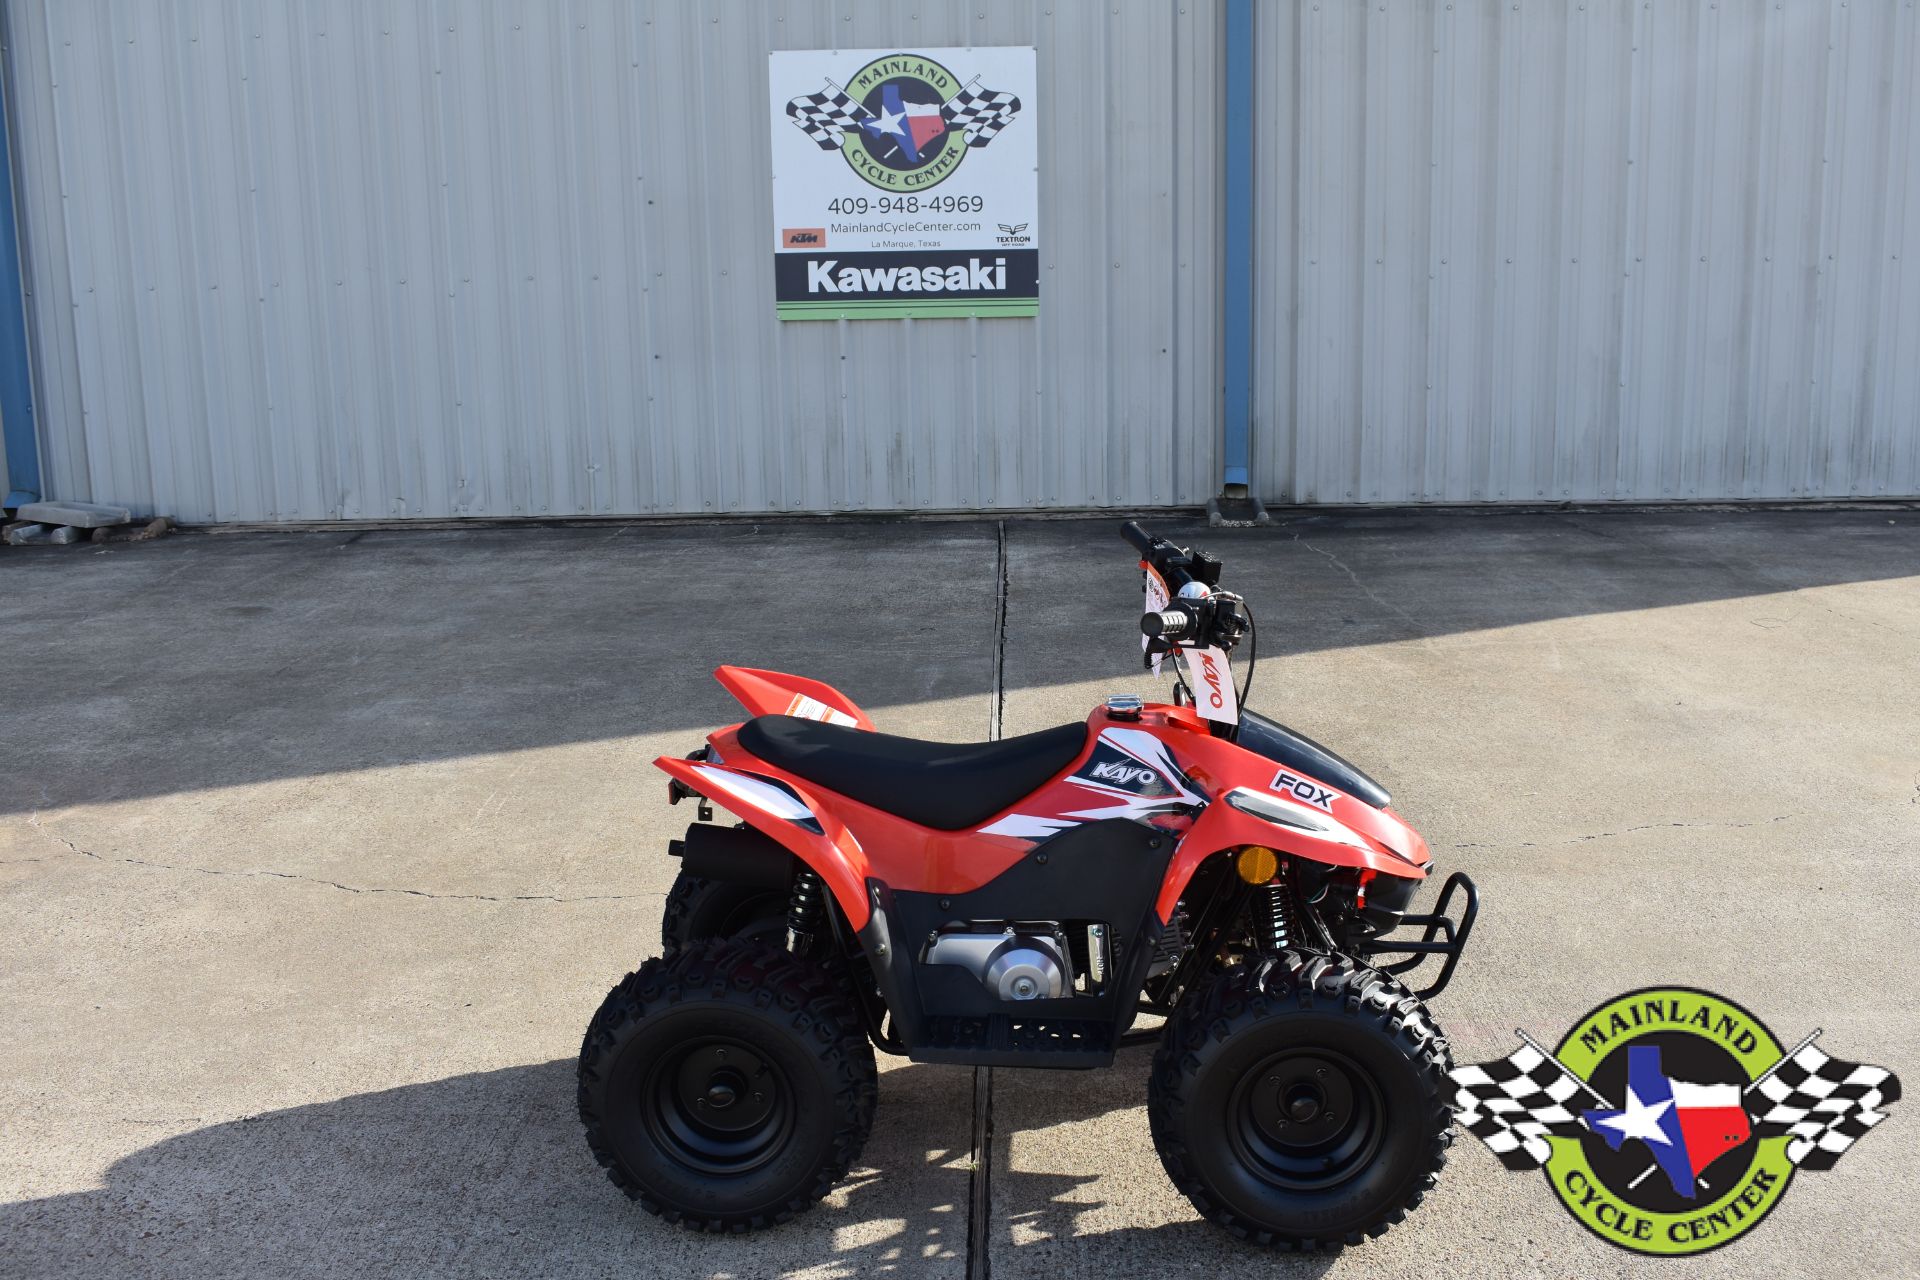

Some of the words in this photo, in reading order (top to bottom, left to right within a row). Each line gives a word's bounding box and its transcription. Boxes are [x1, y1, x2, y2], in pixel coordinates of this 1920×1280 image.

[857, 61, 948, 90] MAINLAND
[851, 148, 897, 186] CYCLE
[903, 146, 960, 187] CENTER
[827, 195, 984, 215] 409-948-4969
[790, 233, 818, 243] KTM
[830, 222, 981, 235] MainlandCycleCenter.com
[871, 240, 881, 248] La
[882, 240, 916, 250] Marque,
[919, 239, 941, 248] Texas
[807, 257, 1007, 293] Kawasaki
[1198, 651, 1223, 709] KAYO
[1089, 758, 1157, 785] KAYO
[1274, 773, 1334, 808] FOX
